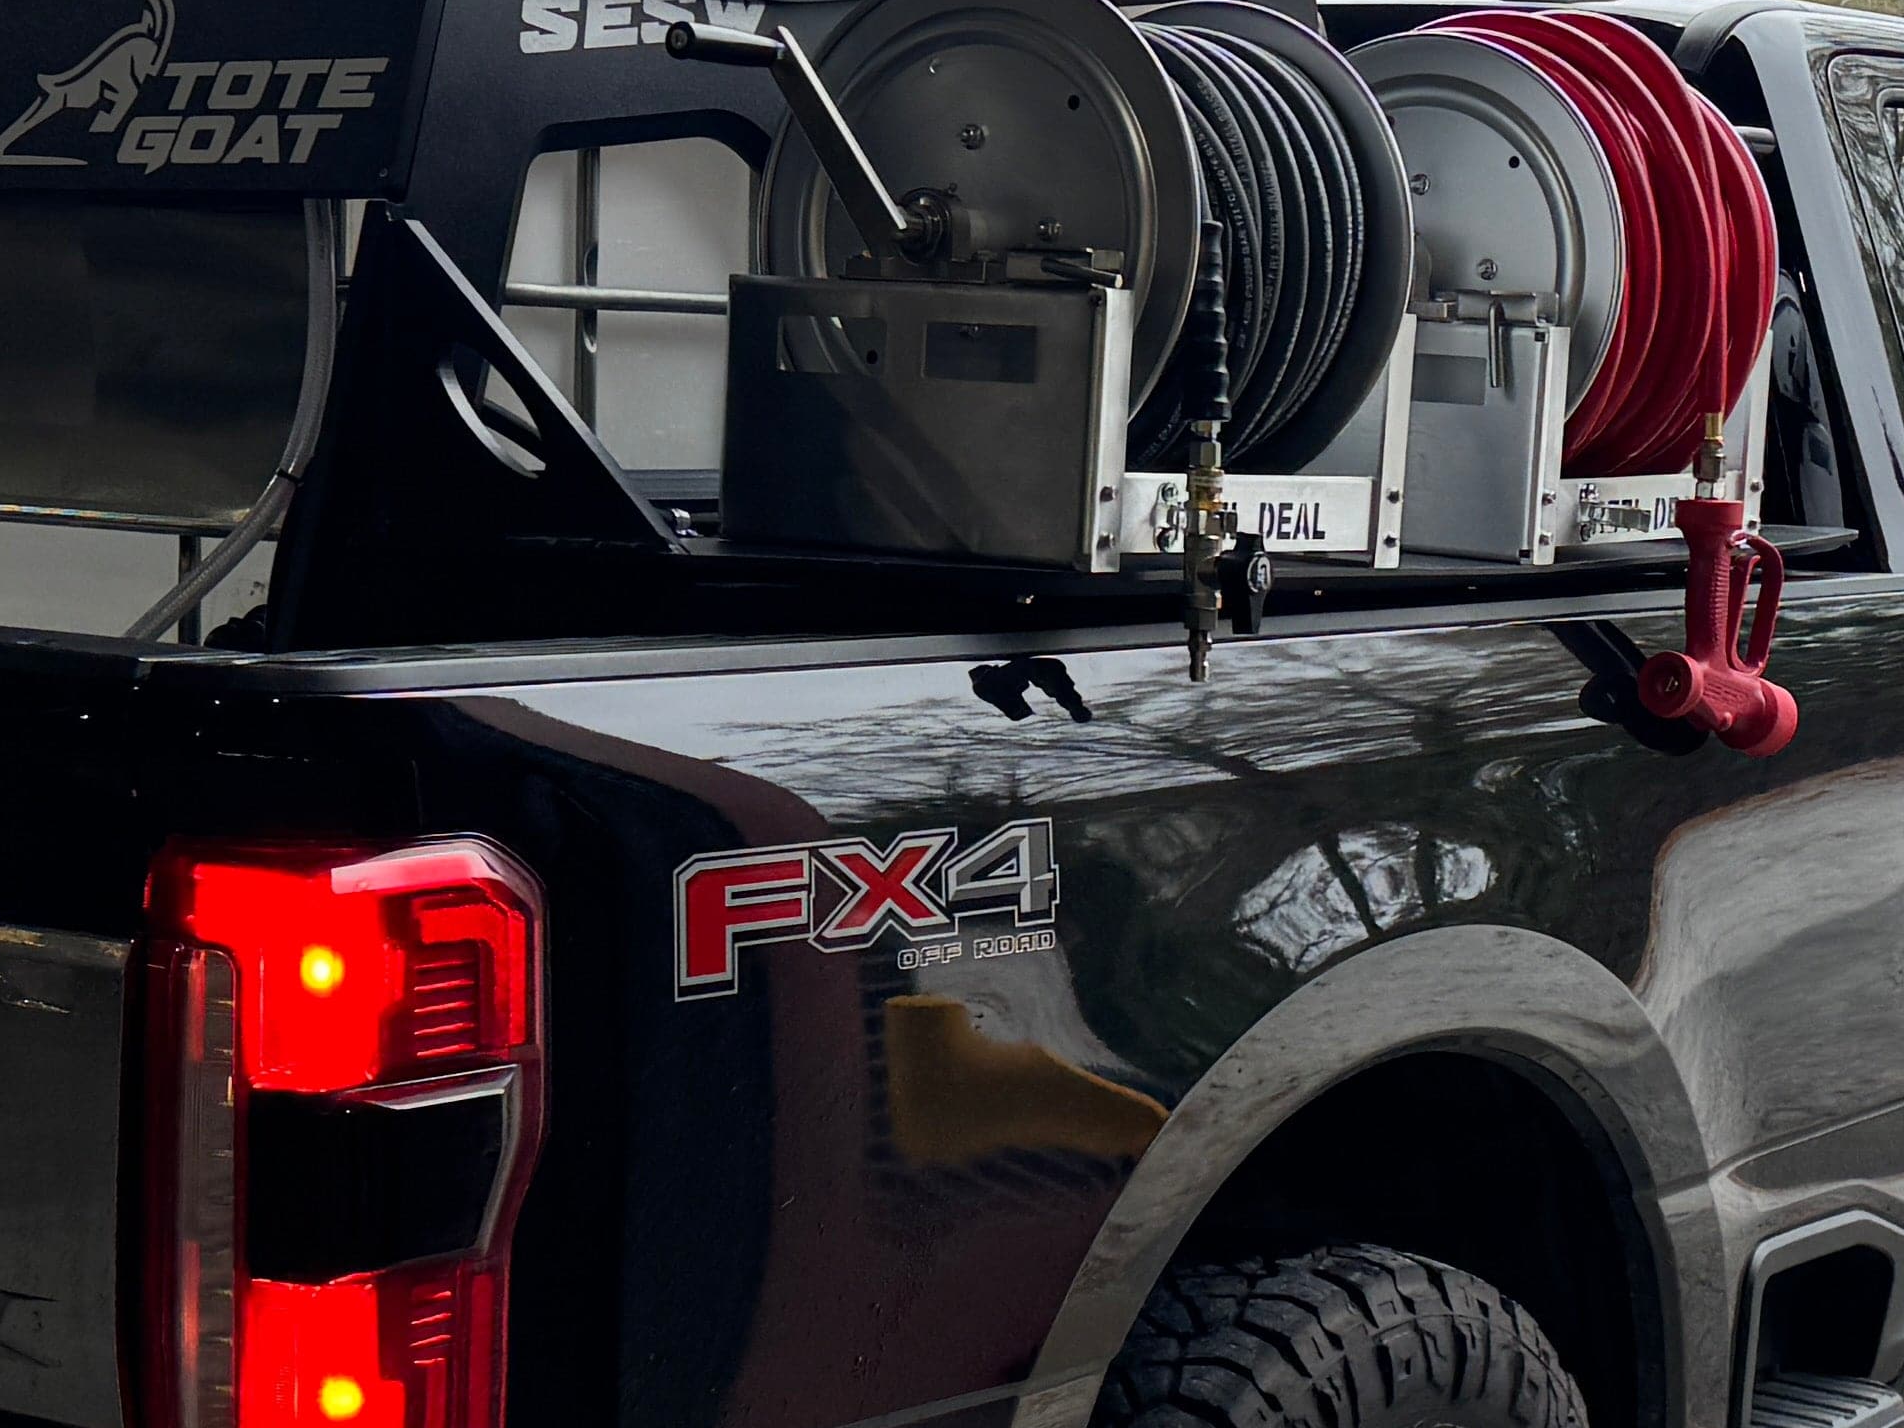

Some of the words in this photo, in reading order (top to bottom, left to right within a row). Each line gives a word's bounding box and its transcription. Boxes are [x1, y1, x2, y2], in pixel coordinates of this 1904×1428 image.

[161, 57, 389, 111] TOTE
[116, 113, 343, 175] GOAT
[1258, 501, 1326, 540] DEAL
[673, 817, 1060, 1003] FX4
[897, 941, 962, 970] OFF
[974, 929, 1056, 959] ROAD
